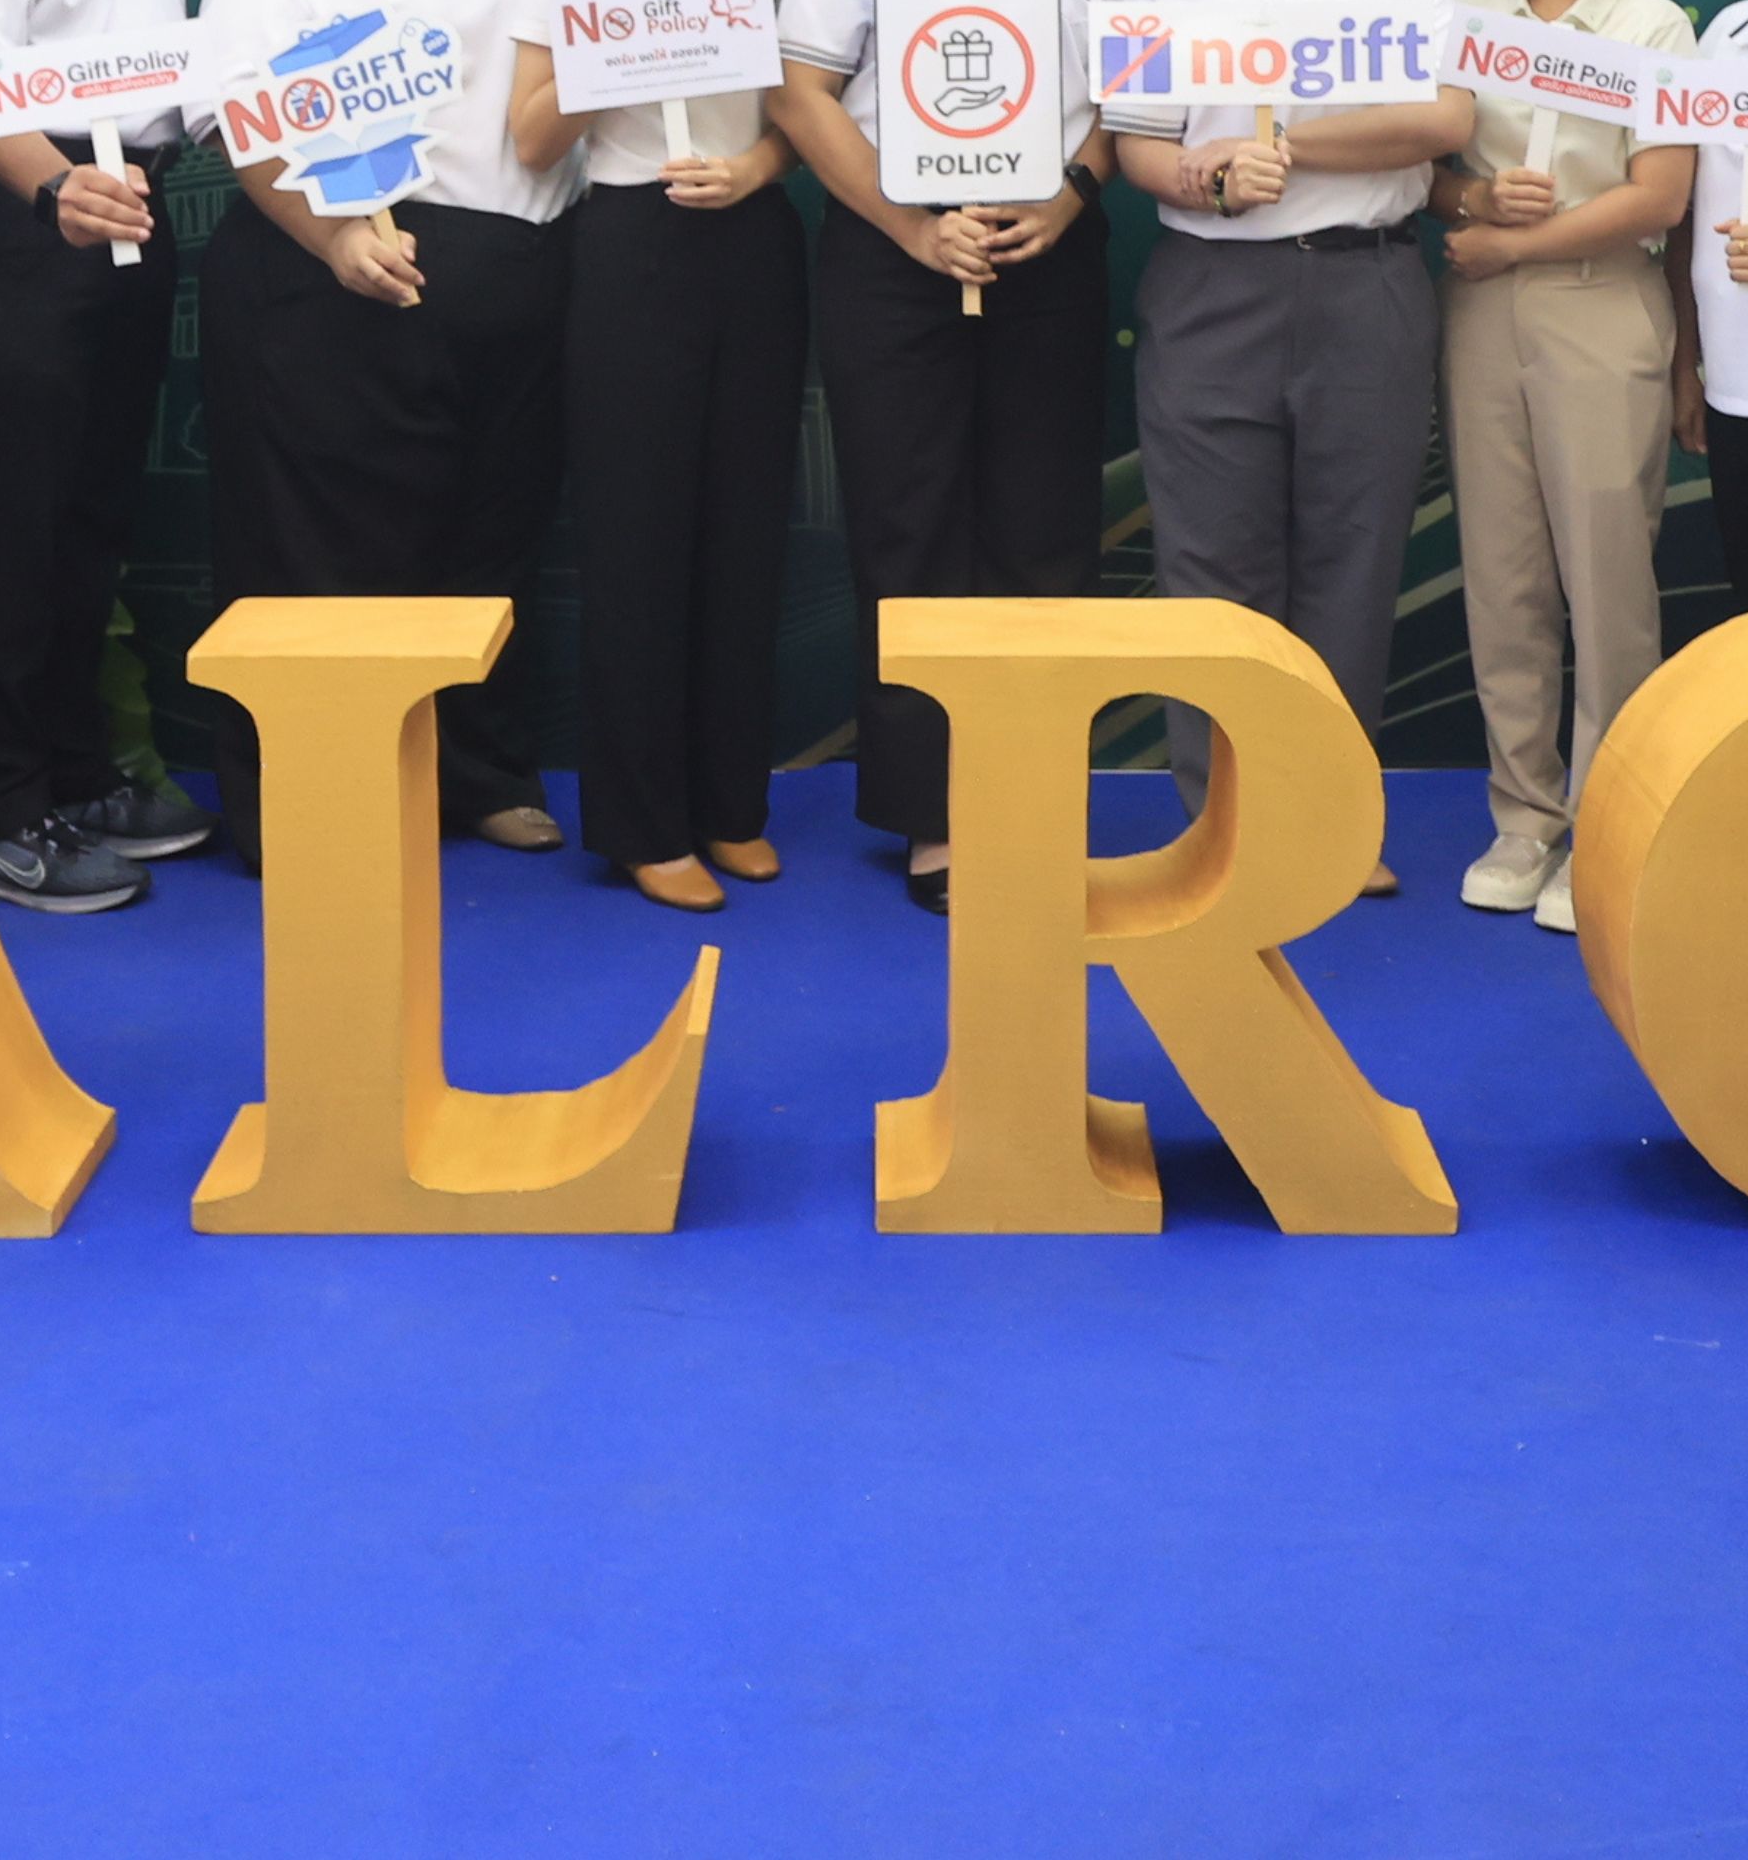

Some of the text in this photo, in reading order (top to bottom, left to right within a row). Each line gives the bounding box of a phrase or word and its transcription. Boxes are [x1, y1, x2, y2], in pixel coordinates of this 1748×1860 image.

[646, 13, 710, 35] Policy
[67, 60, 112, 83] Gift
[116, 50, 189, 75] Policy
[333, 48, 407, 92] GIFT
[1534, 54, 1574, 80] Gift
[1580, 65, 1638, 96] Polic
[341, 64, 455, 121] POLICY
[916, 152, 1024, 177] POLICY
